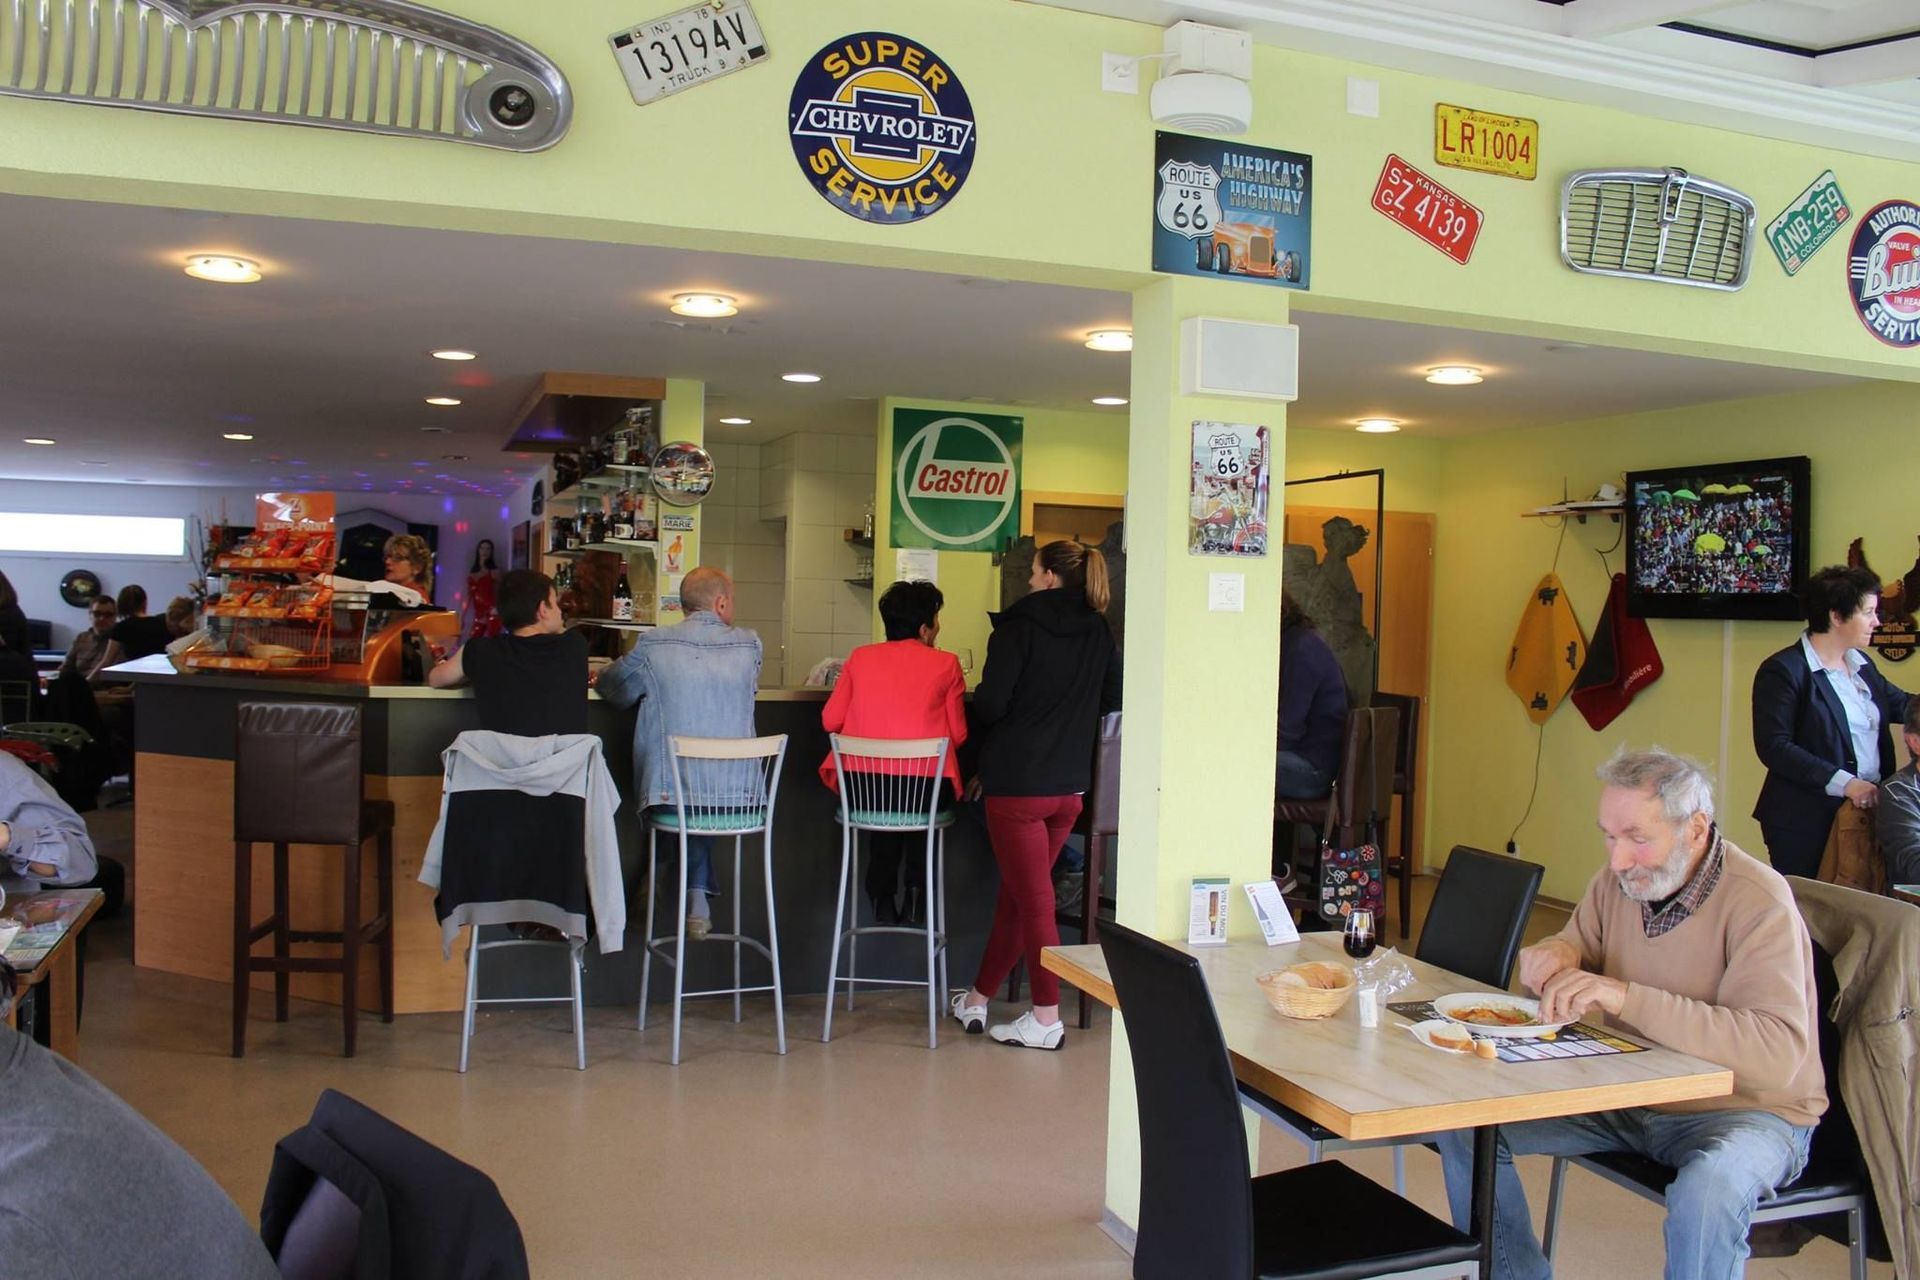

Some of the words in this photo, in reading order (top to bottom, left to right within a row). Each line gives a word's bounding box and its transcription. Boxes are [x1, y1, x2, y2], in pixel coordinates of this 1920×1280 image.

[650, 21, 673, 37] IND
[632, 12, 747, 80] 13194V
[668, 65, 713, 87] TRUCK
[822, 38, 949, 94] SUPER
[808, 107, 963, 146] CHEVROLET
[809, 148, 958, 215] SERVICE
[1169, 167, 1211, 187] ROUTE
[1221, 152, 1305, 190] AMERICA'S
[1179, 189, 1202, 200] US
[1229, 180, 1304, 216] HIGHWAY
[1415, 177, 1456, 208] KANSAS
[1173, 202, 1208, 230] 66
[1800, 219, 1837, 258] COLORADO
[1887, 241, 1911, 252] VALVE
[1214, 437, 1236, 446] ROUTE
[918, 463, 1010, 496] Castrol
[1217, 457, 1239, 474] 66
[664, 520, 692, 529] MARIE
